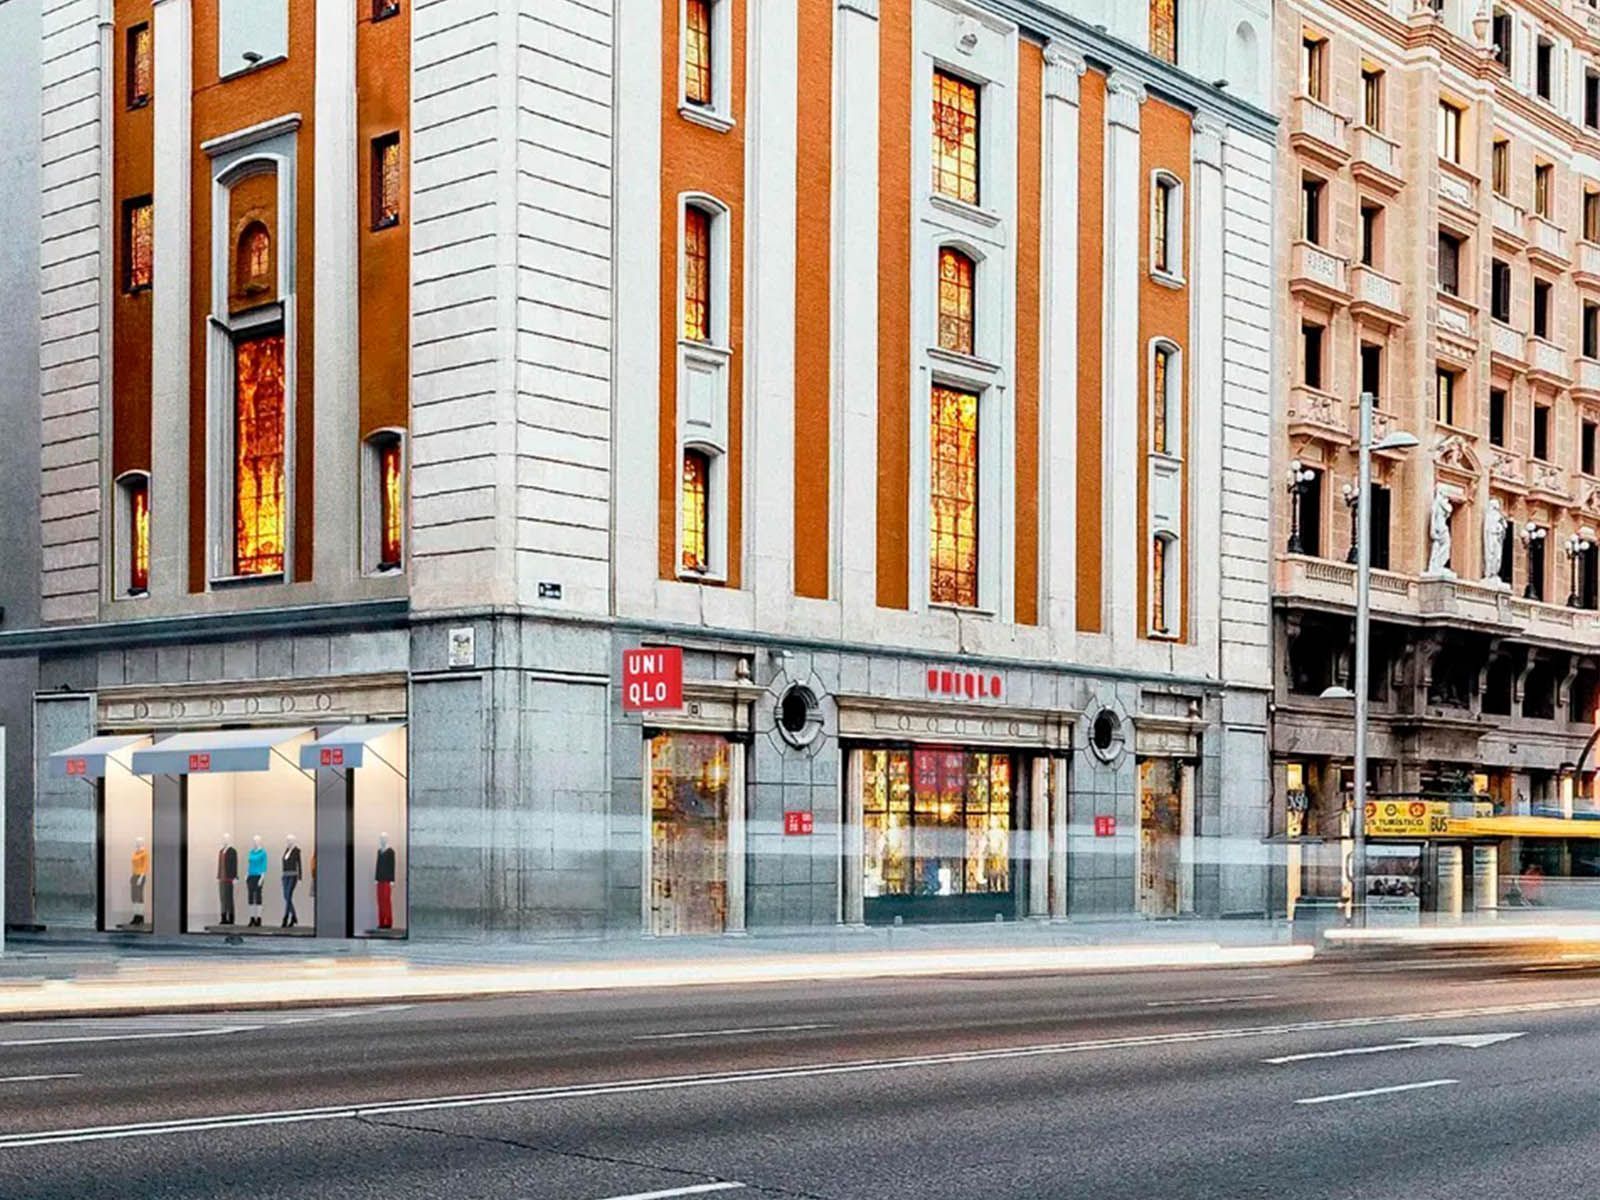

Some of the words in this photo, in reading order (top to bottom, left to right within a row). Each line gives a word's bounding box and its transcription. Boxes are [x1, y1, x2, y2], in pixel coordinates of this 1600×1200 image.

[629, 654, 663, 674] UNI
[629, 681, 666, 706] QLO
[928, 670, 1001, 699] UNIQLO
